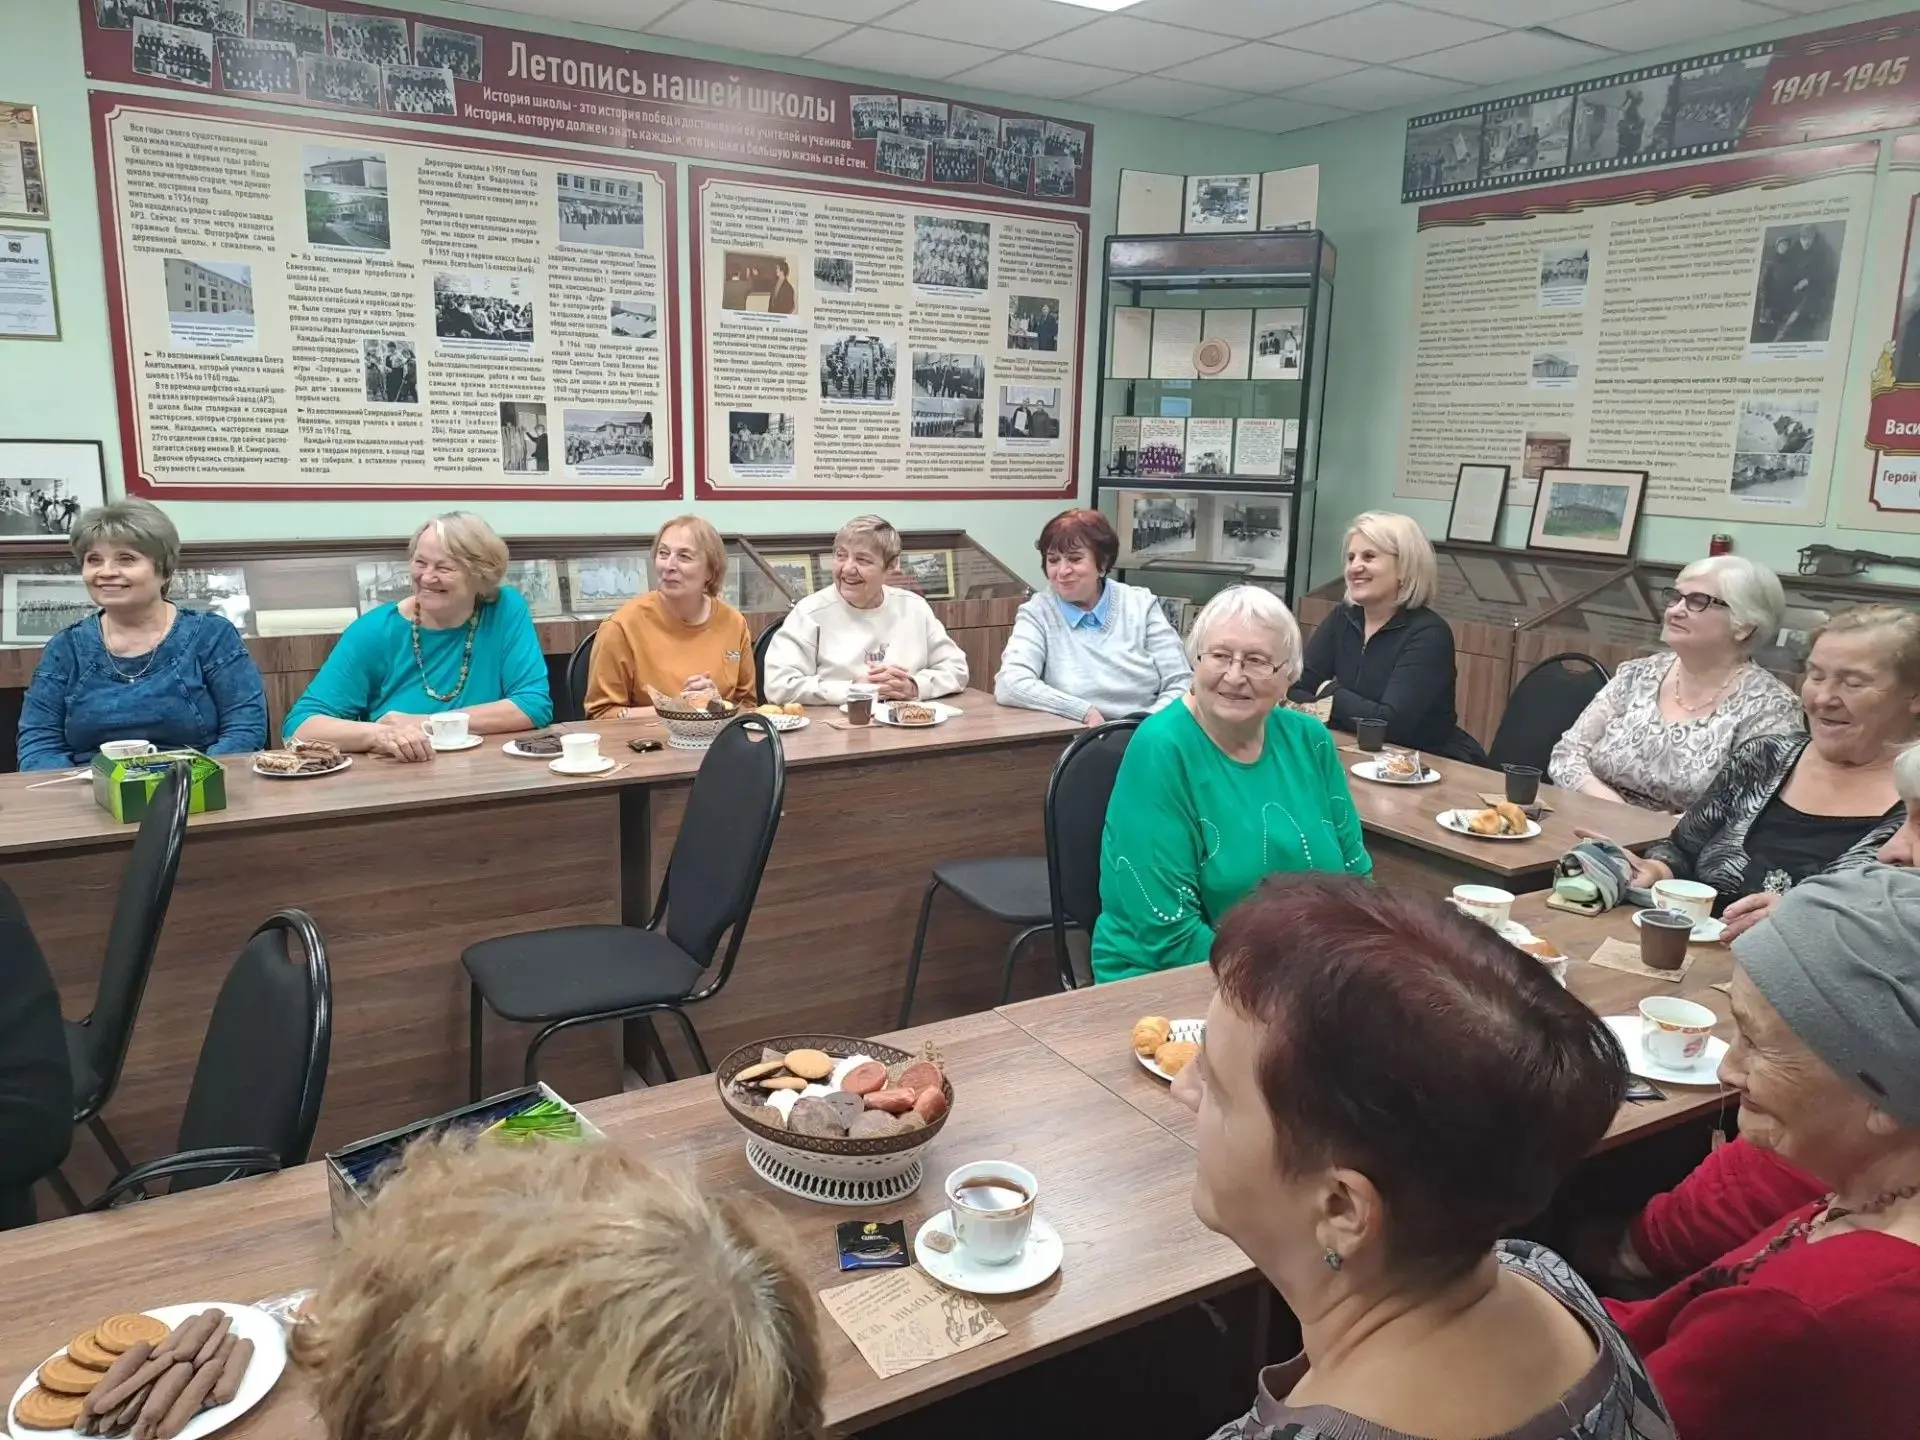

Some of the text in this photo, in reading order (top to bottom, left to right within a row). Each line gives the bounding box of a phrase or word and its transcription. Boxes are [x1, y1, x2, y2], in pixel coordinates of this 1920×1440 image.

[508, 41, 836, 123] Летопись нашей школы
[1771, 56, 1910, 105] 1941-1945
[465, 104, 516, 124] История,
[518, 112, 565, 131] которую
[567, 120, 607, 134] должен
[609, 127, 638, 139] знать
[687, 136, 702, 148] кто
[747, 142, 790, 160] большую
[792, 150, 821, 163] жизнь
[822, 154, 833, 164] из
[834, 154, 845, 166] её
[846, 157, 869, 169] стен.
[483, 87, 531, 106] История
[533, 97, 572, 112] школы
[580, 103, 596, 114] это
[598, 106, 640, 121] история
[642, 111, 673, 125] побед
[674, 116, 681, 125] и
[682, 117, 743, 134] достижений
[757, 128, 800, 144] учителей
[801, 134, 808, 143] и
[808, 135, 854, 150] учеников.
[167, 352, 219, 360] воспоминаний
[1883, 470, 1917, 485] Герой
